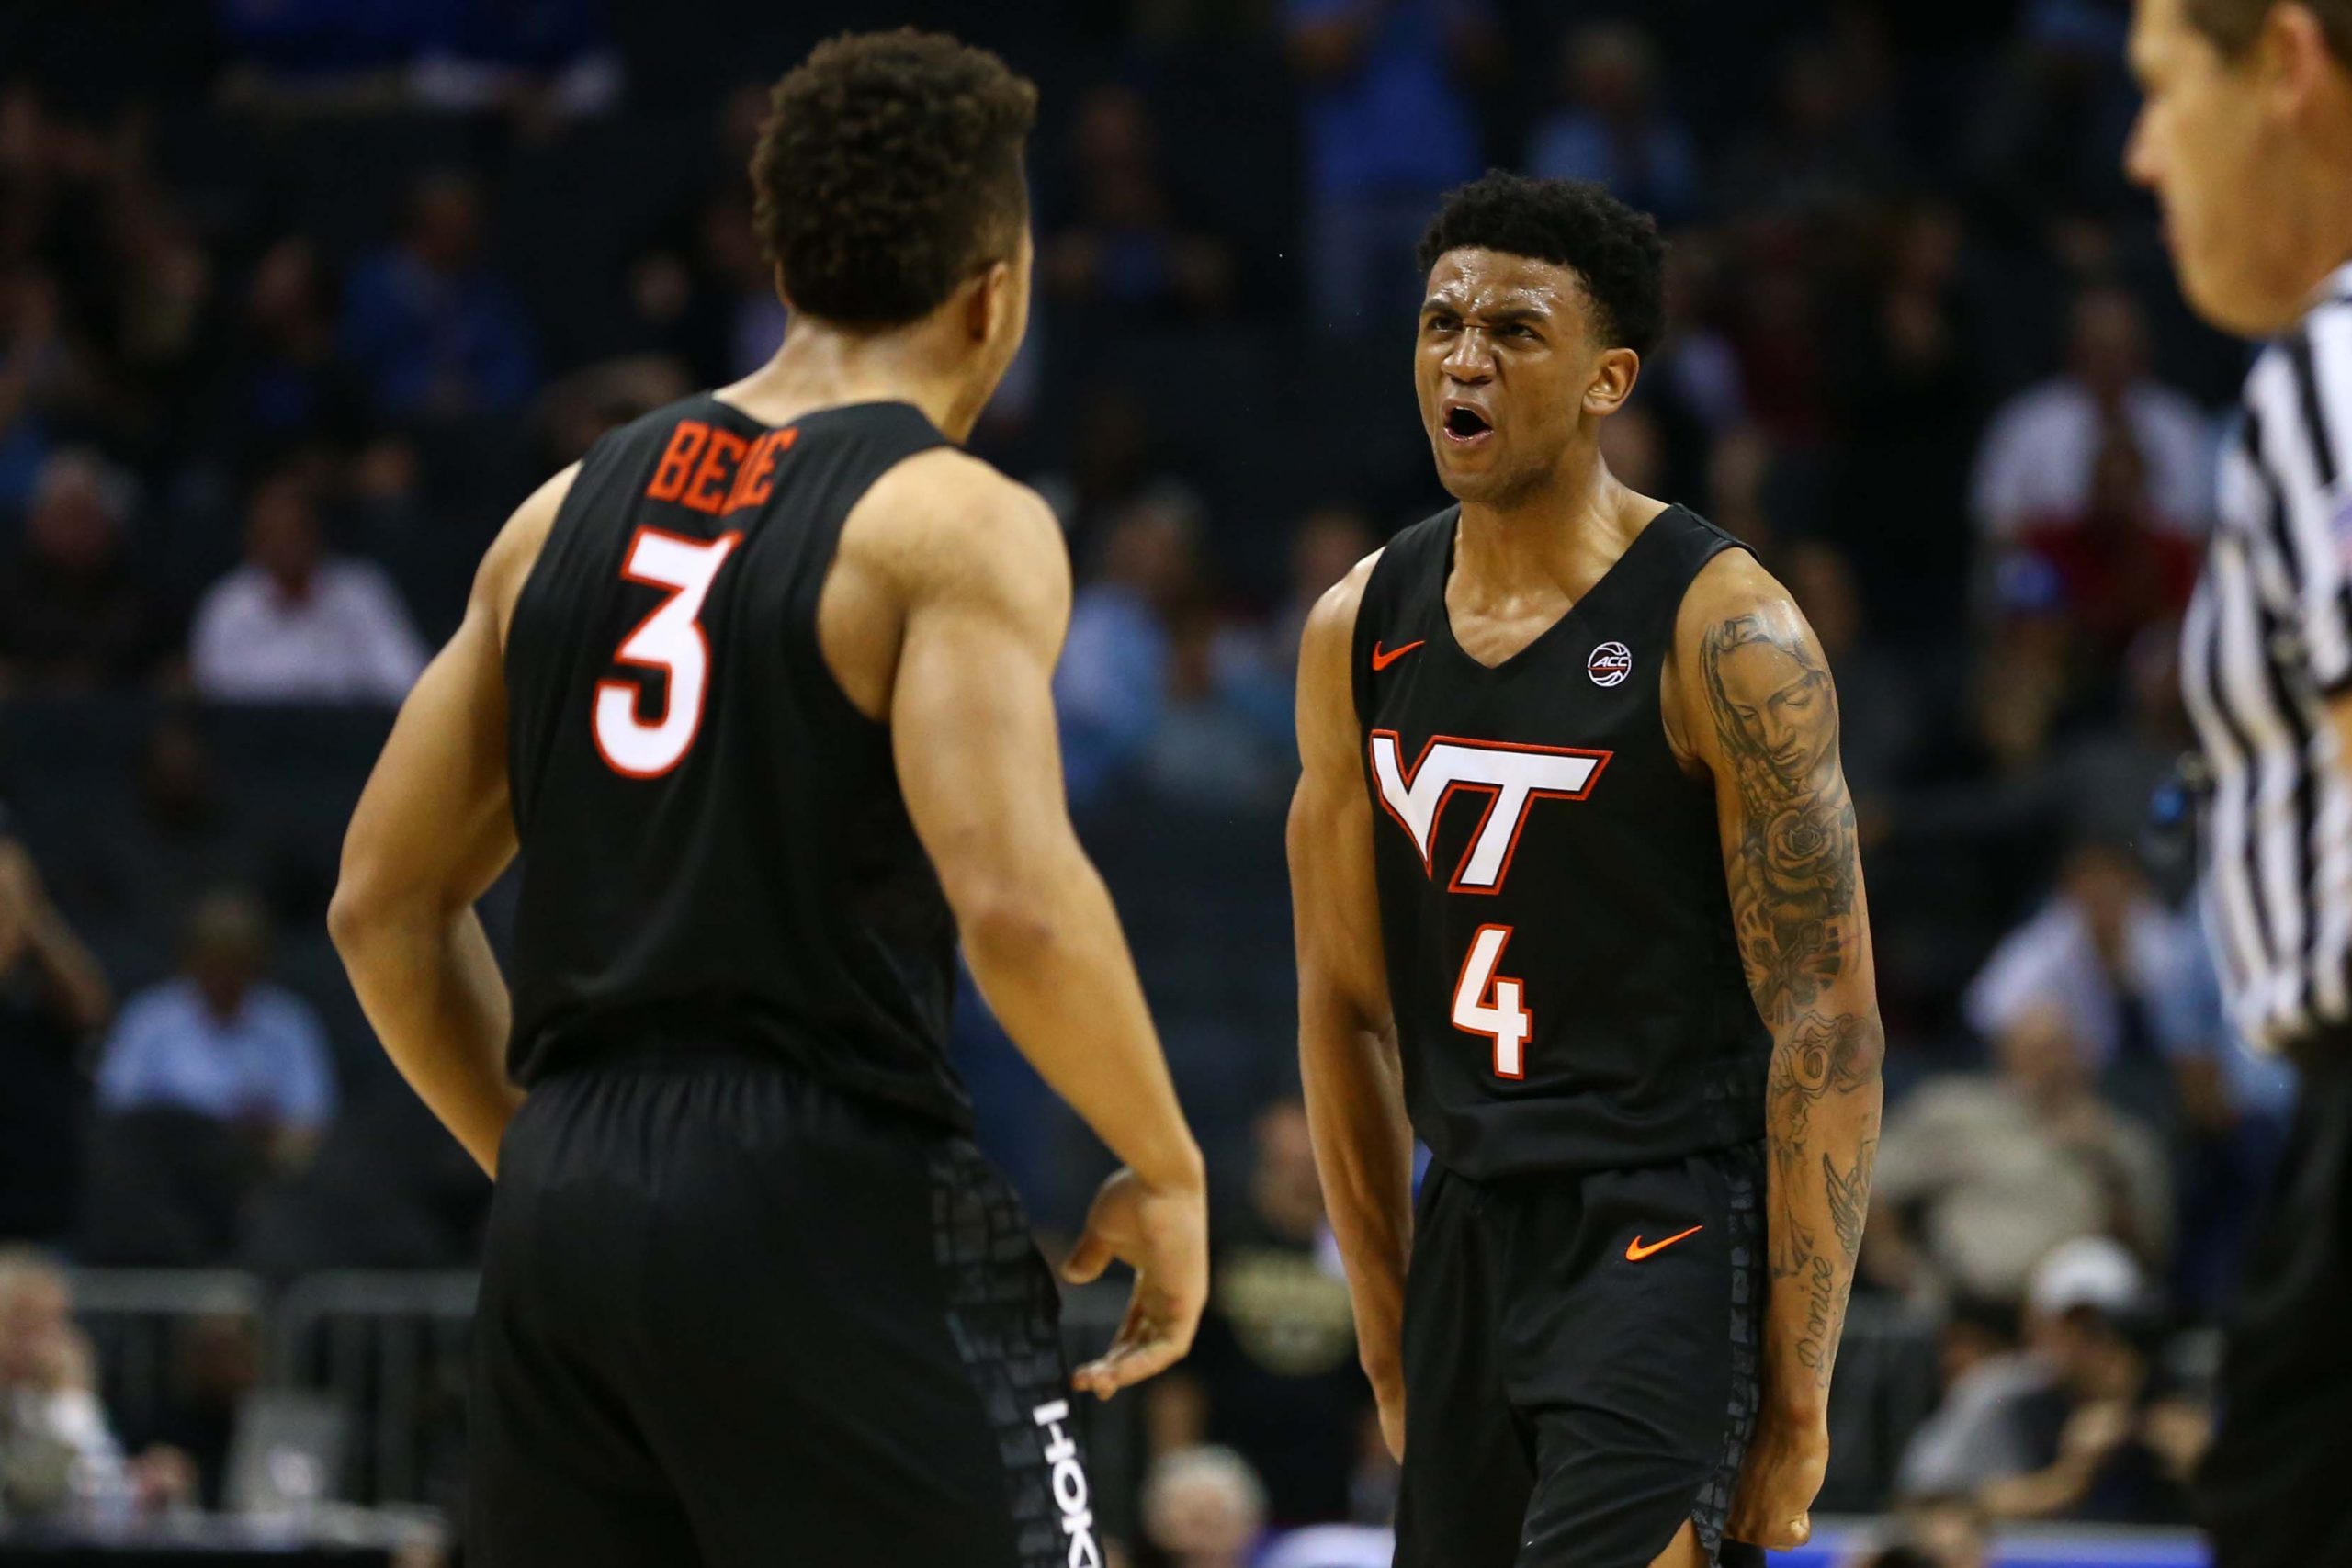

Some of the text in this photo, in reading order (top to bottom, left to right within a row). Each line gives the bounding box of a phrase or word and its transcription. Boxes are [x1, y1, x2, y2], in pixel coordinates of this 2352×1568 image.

[591, 525, 744, 781] 3
[1592, 656, 1631, 668] ACC
[1370, 729, 1614, 895] VT
[1451, 923, 1532, 1080] 4
